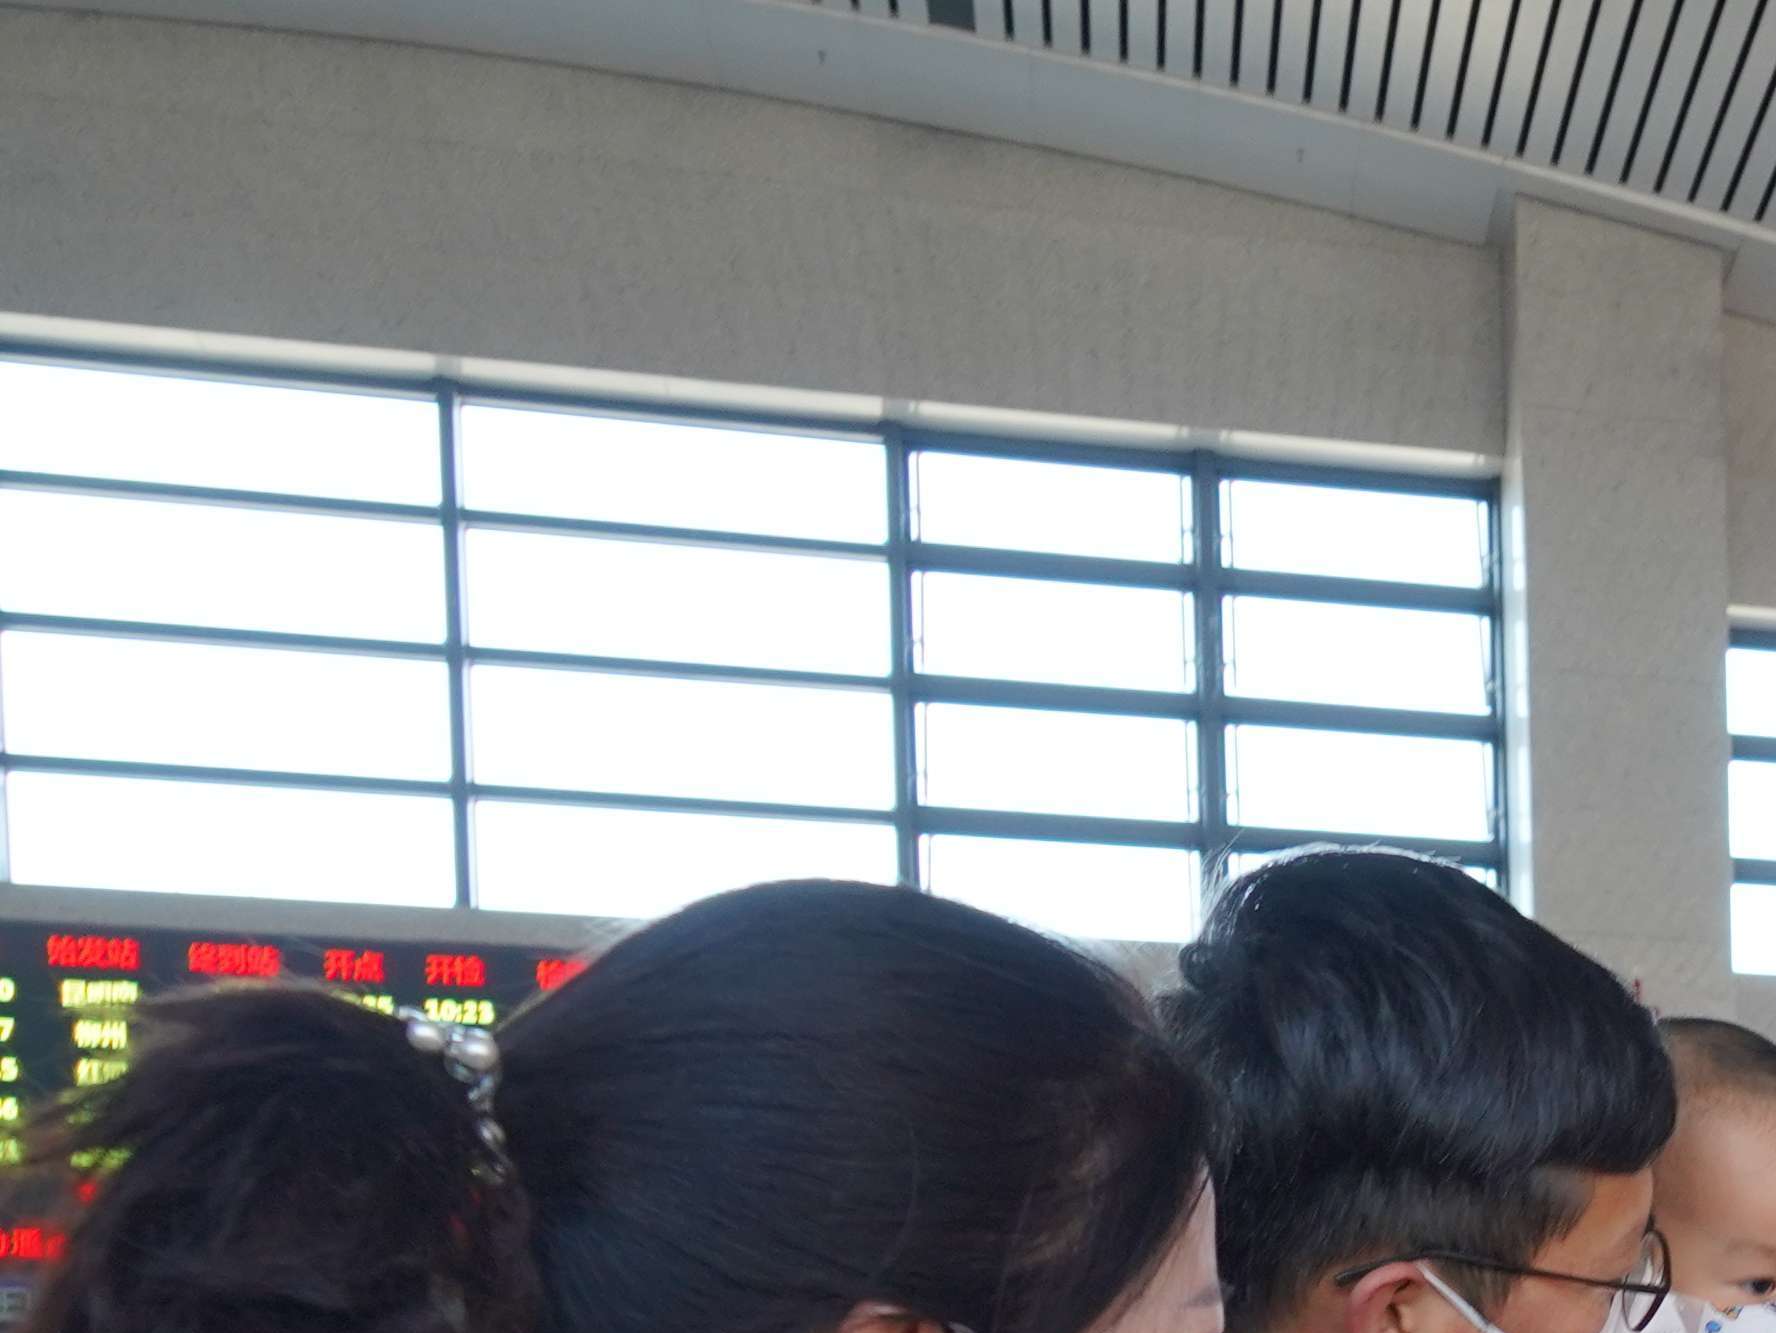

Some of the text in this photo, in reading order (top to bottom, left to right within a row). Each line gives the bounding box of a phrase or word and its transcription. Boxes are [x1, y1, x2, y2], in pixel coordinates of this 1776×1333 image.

[46, 933, 140, 971] 始发站
[323, 949, 385, 983] 开点
